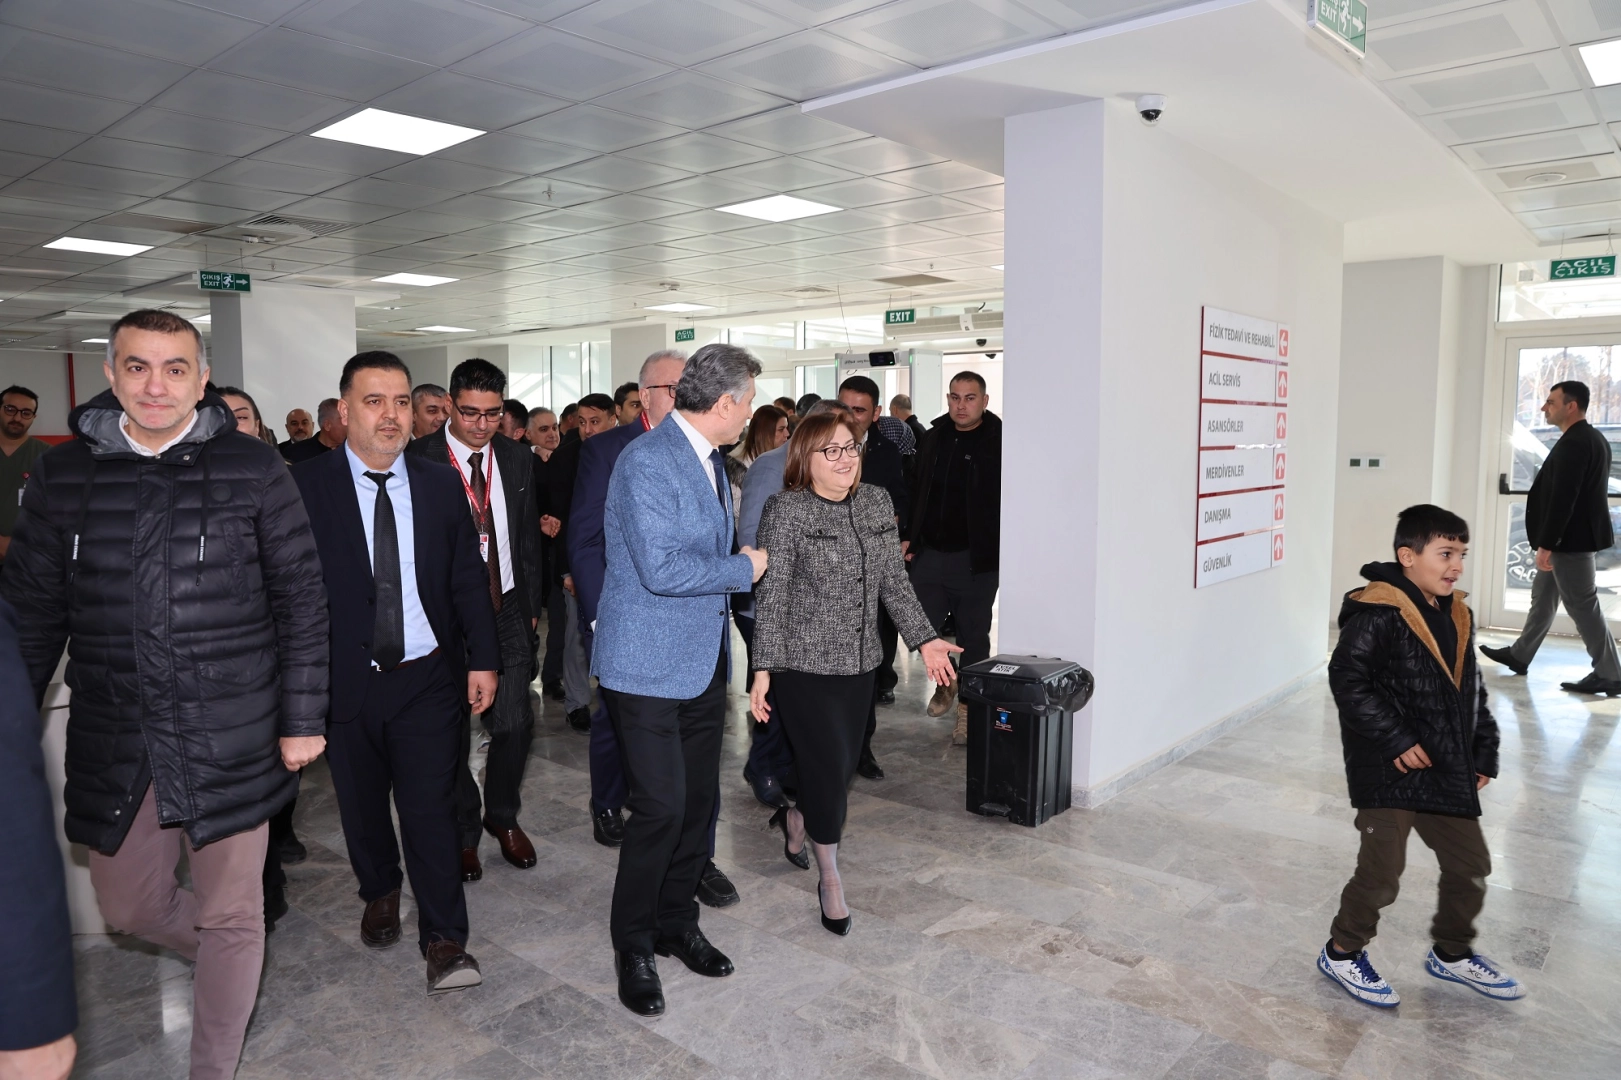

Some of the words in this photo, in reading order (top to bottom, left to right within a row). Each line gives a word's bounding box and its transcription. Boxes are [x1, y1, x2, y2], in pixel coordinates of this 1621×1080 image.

[1321, 1, 1337, 22] EXIT
[1554, 265, 1611, 277] ÇIKIŞ
[889, 311, 910, 322] EXIT
[1209, 322, 1224, 340] FİZİK
[1224, 328, 1244, 344] TEDAVİ
[1244, 331, 1251, 345] VE
[1208, 370, 1222, 387] ACİL
[1222, 372, 1241, 388] SERVİS
[1207, 418, 1244, 433] ASANSÖRLER
[1206, 463, 1245, 480] MERDİVENLER
[1204, 508, 1231, 524] DANIŞMA
[1203, 553, 1232, 573] GÜVENLİK
